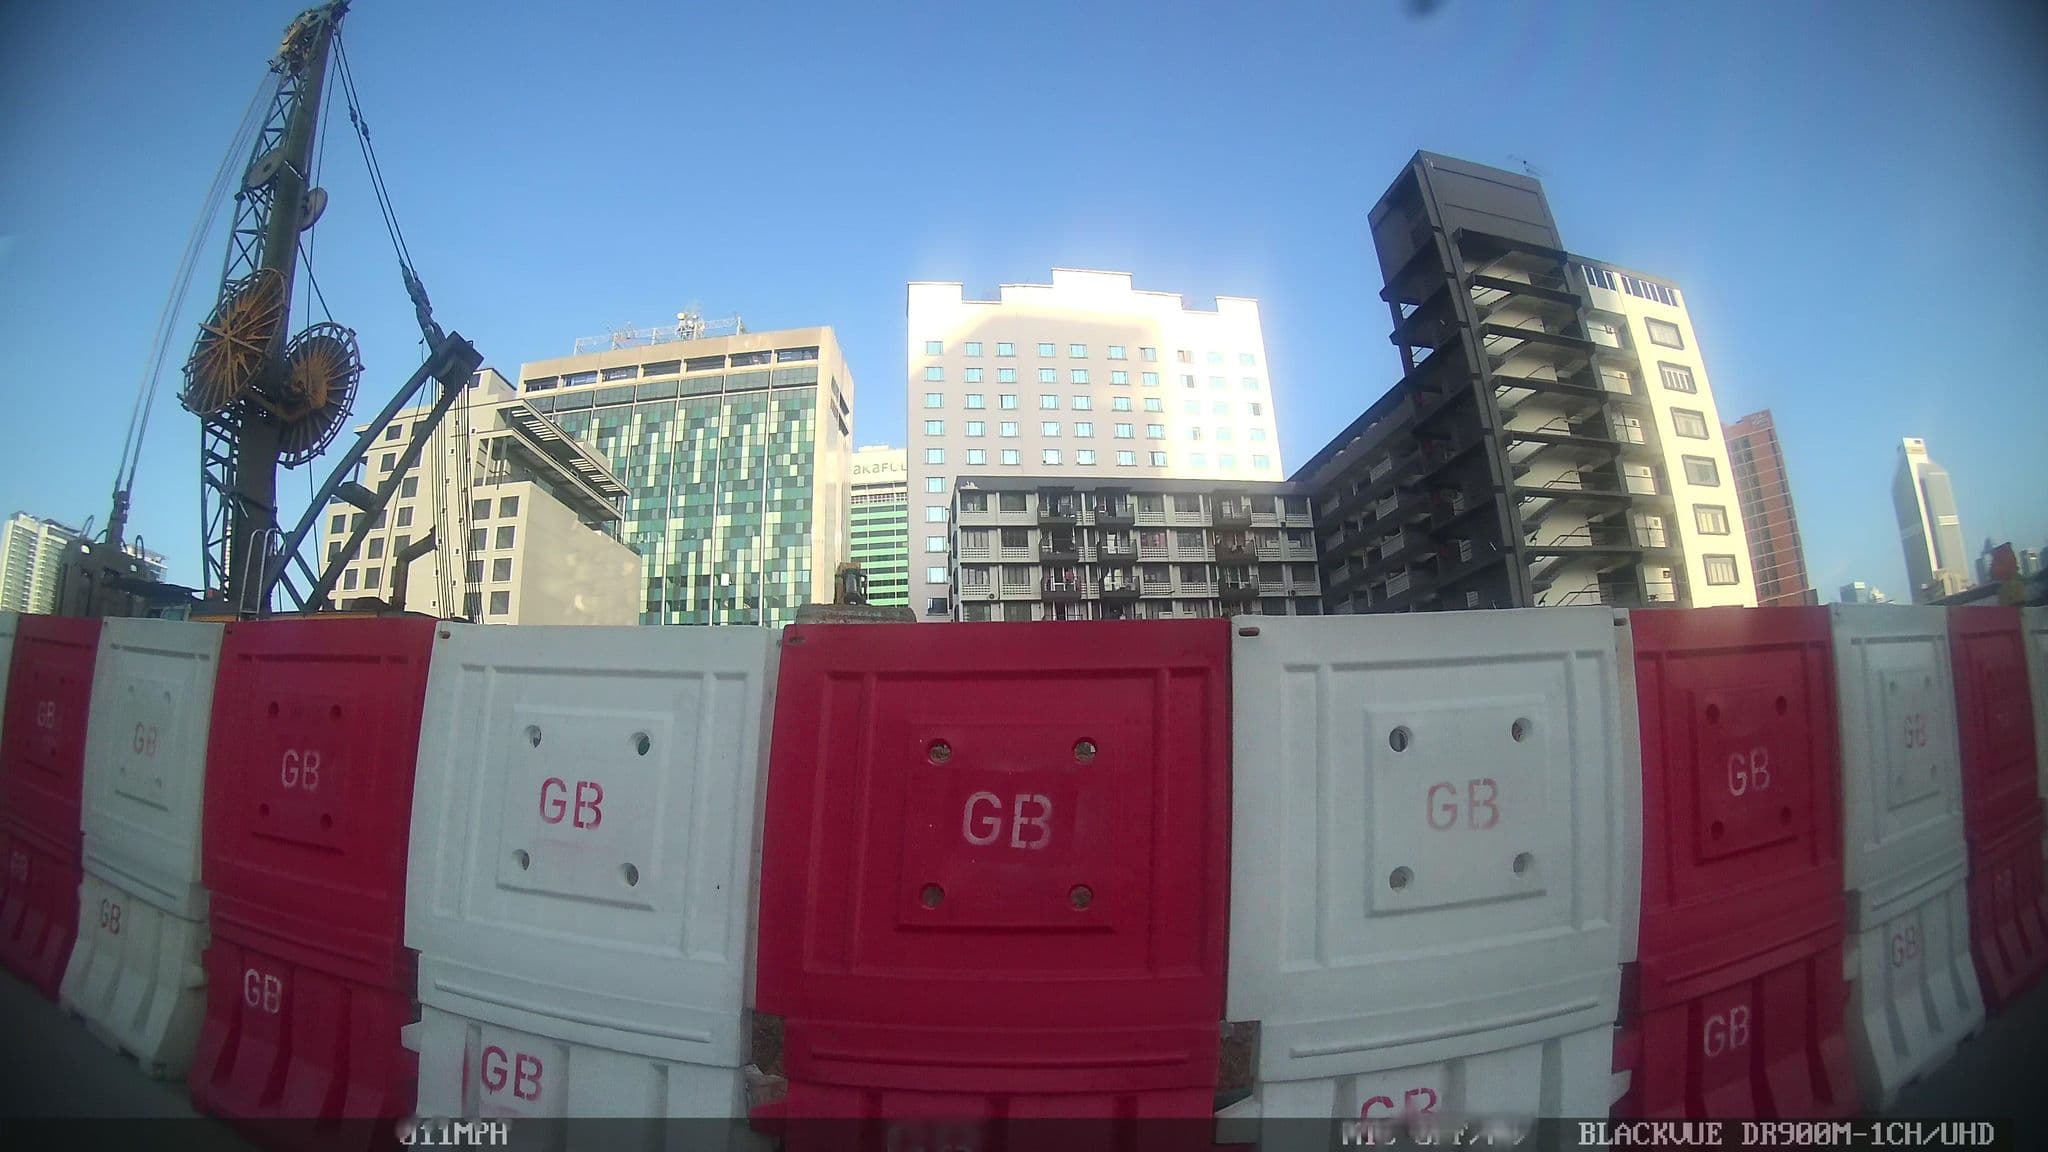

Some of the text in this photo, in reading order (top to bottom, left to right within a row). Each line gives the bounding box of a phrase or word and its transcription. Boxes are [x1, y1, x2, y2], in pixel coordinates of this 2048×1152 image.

[133, 721, 158, 757] GB
[281, 749, 320, 792] GB
[1727, 747, 1770, 796] GB
[538, 776, 604, 829] GB
[961, 790, 1054, 851] GB
[1426, 777, 1499, 831] GB
[100, 898, 121, 935] GB
[244, 968, 283, 1014] GB
[1703, 1005, 1749, 1058] GB
[481, 1045, 543, 1101] GB
